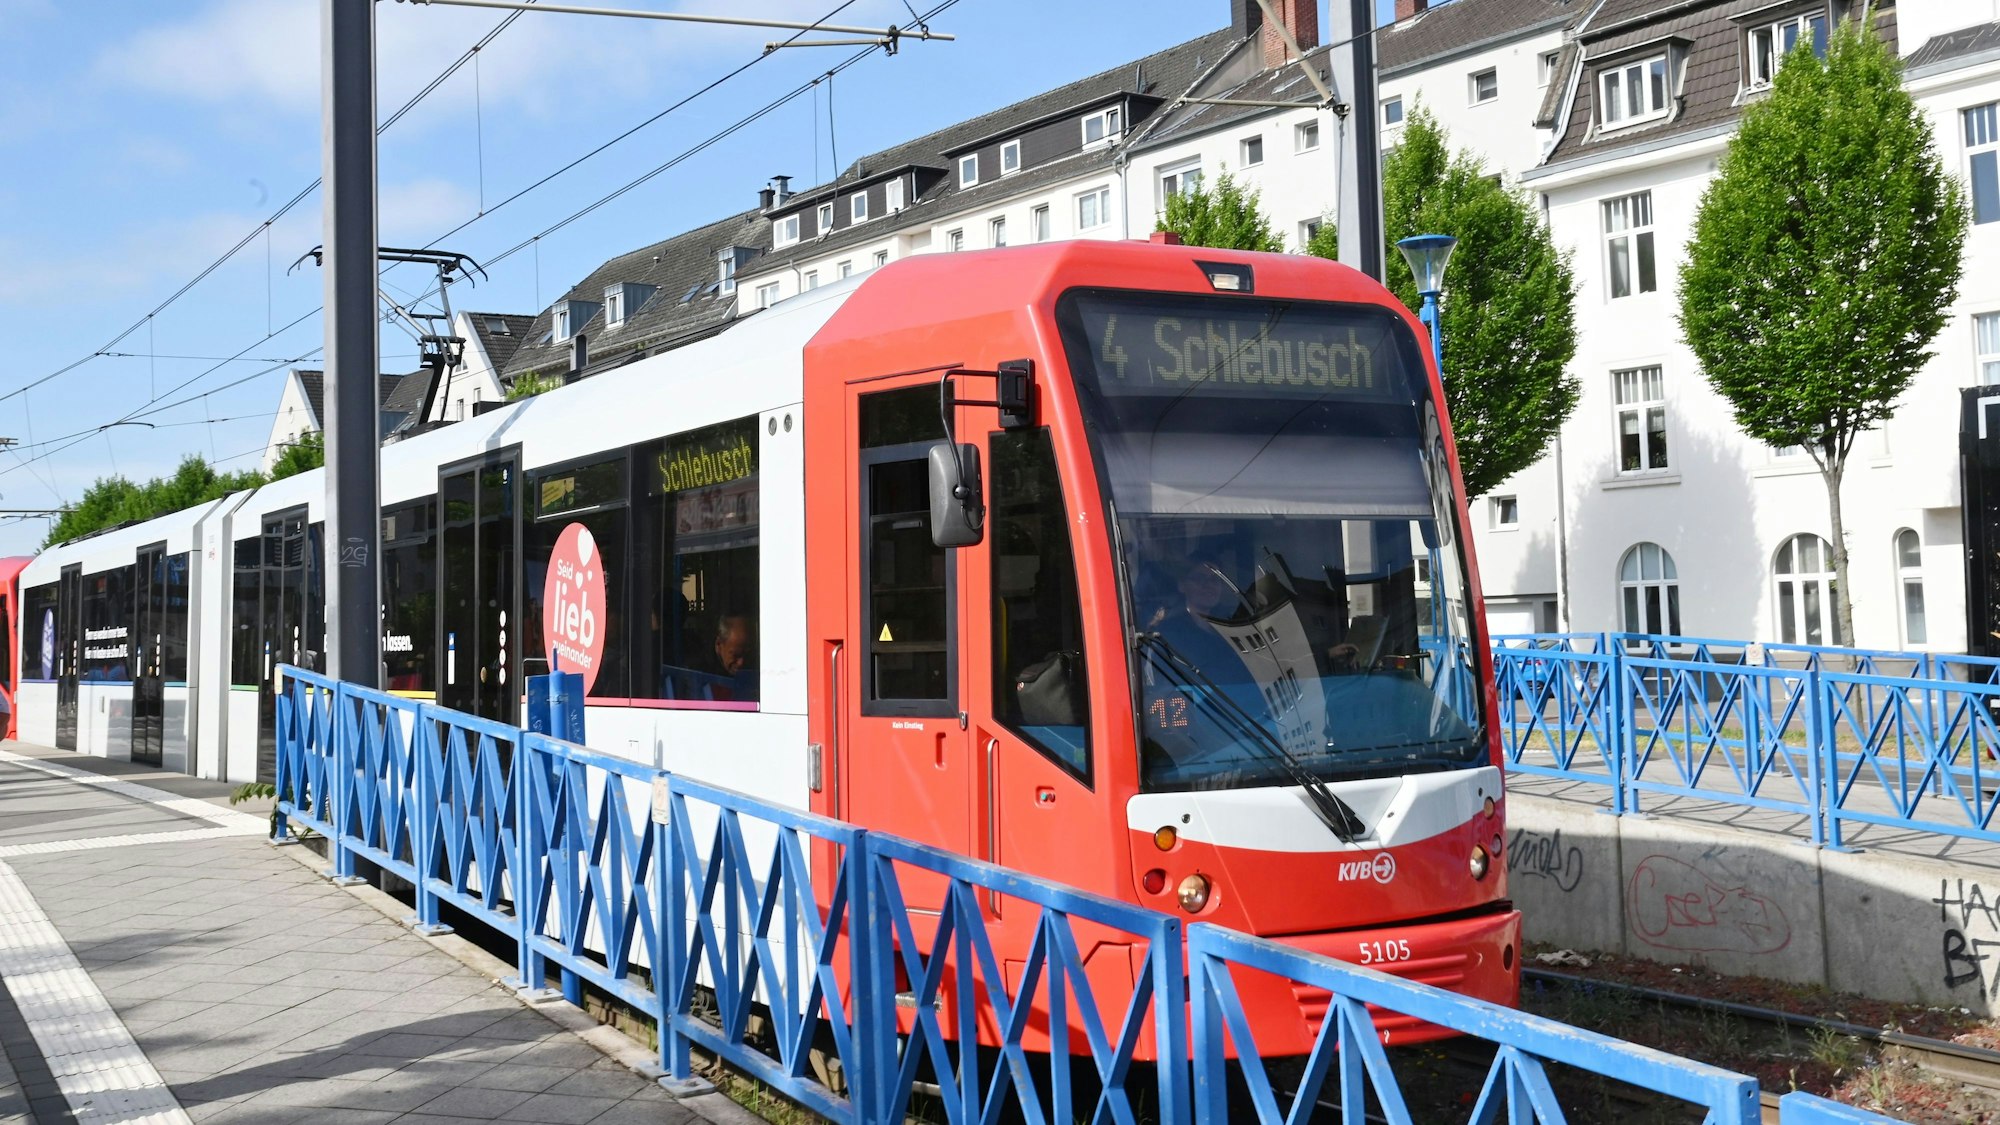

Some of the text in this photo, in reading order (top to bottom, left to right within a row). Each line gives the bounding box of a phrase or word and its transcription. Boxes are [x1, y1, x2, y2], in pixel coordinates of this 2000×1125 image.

[1101, 314, 1373, 389] 4 Schlebusch
[658, 434, 752, 493] Schlebusch
[557, 558, 574, 581] Seid
[553, 580, 595, 649] lieb
[904, 721, 924, 731] Einstieg
[1149, 697, 1188, 728] 12
[1337, 860, 1373, 882] KVB
[1358, 939, 1411, 965] 5105
